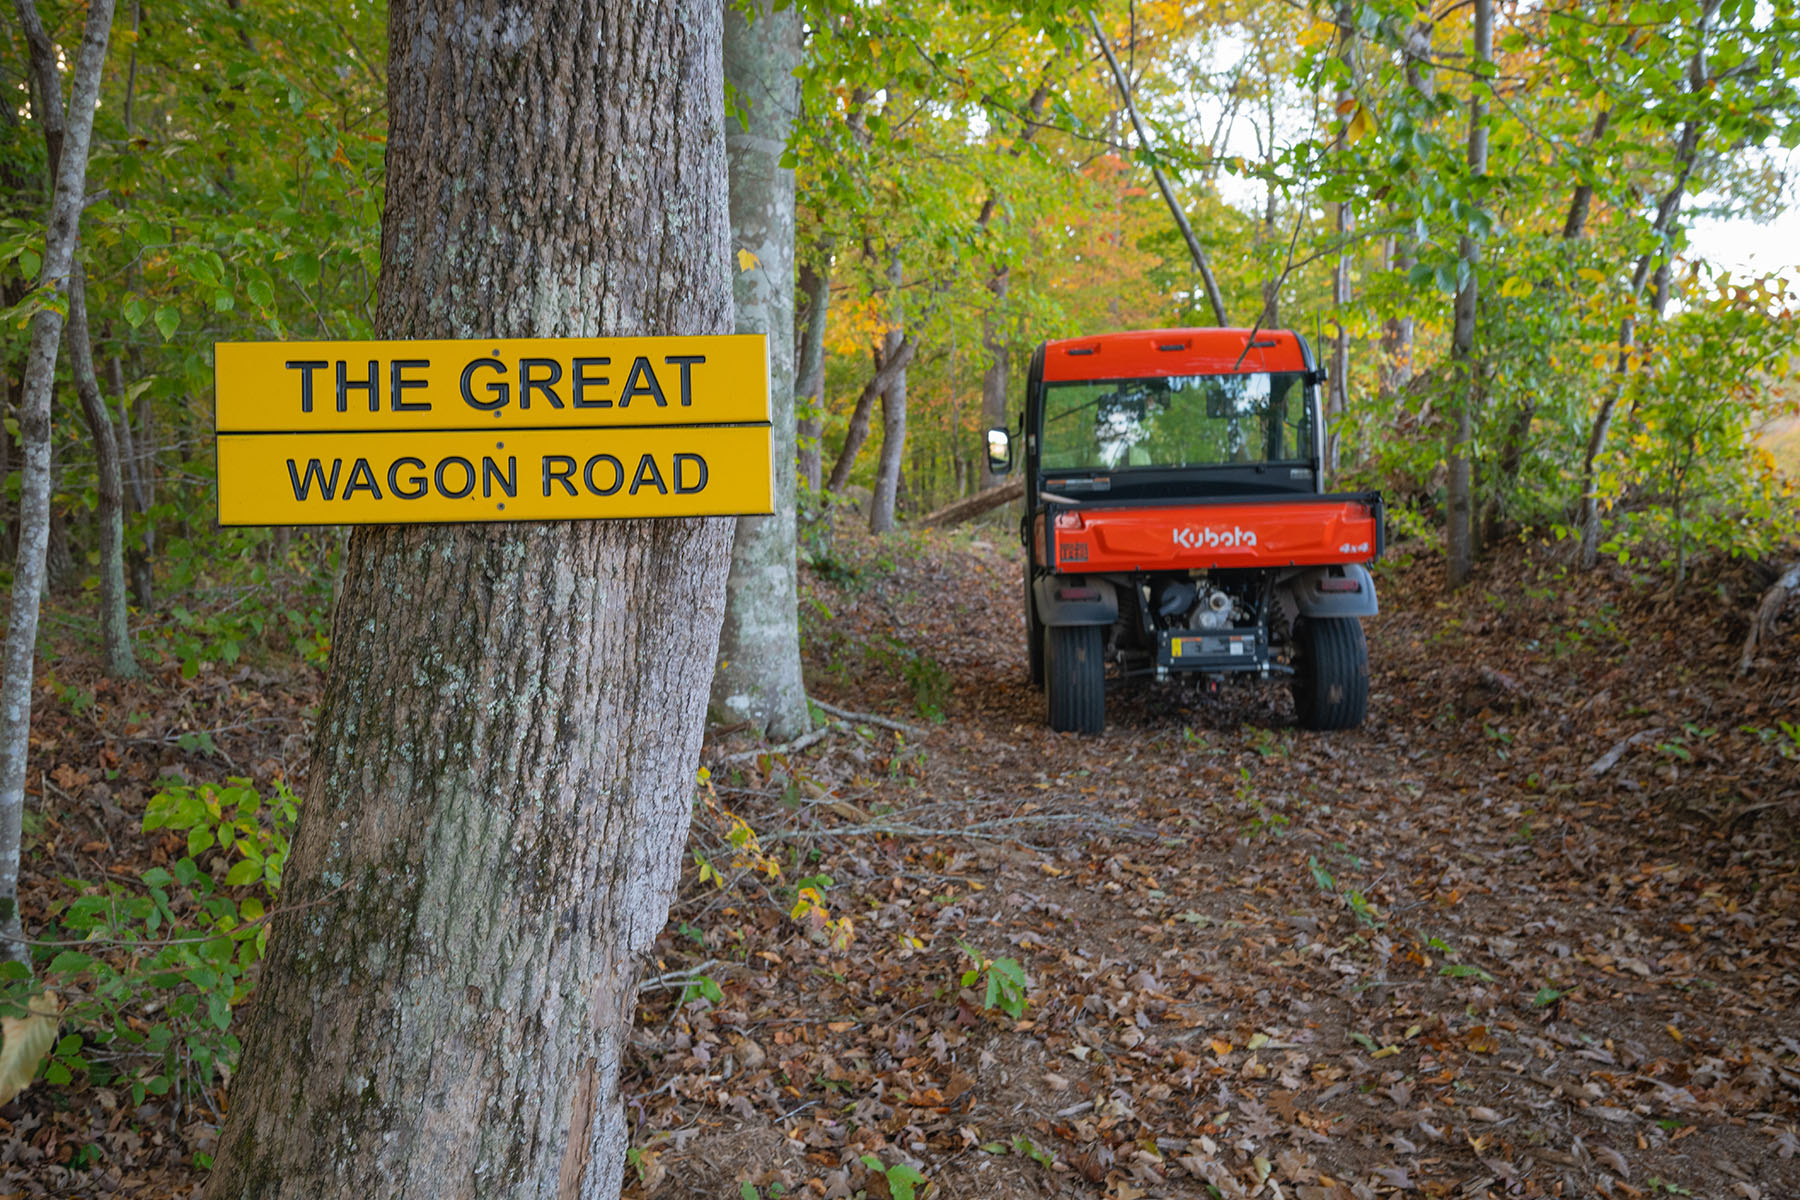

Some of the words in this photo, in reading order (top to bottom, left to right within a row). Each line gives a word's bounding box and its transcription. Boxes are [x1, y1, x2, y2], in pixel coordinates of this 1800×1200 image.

[285, 359, 433, 414] THE
[459, 354, 707, 412] GREAT
[286, 455, 518, 502] WAGON
[541, 452, 709, 497] ROAD
[1173, 527, 1257, 548] Kubota
